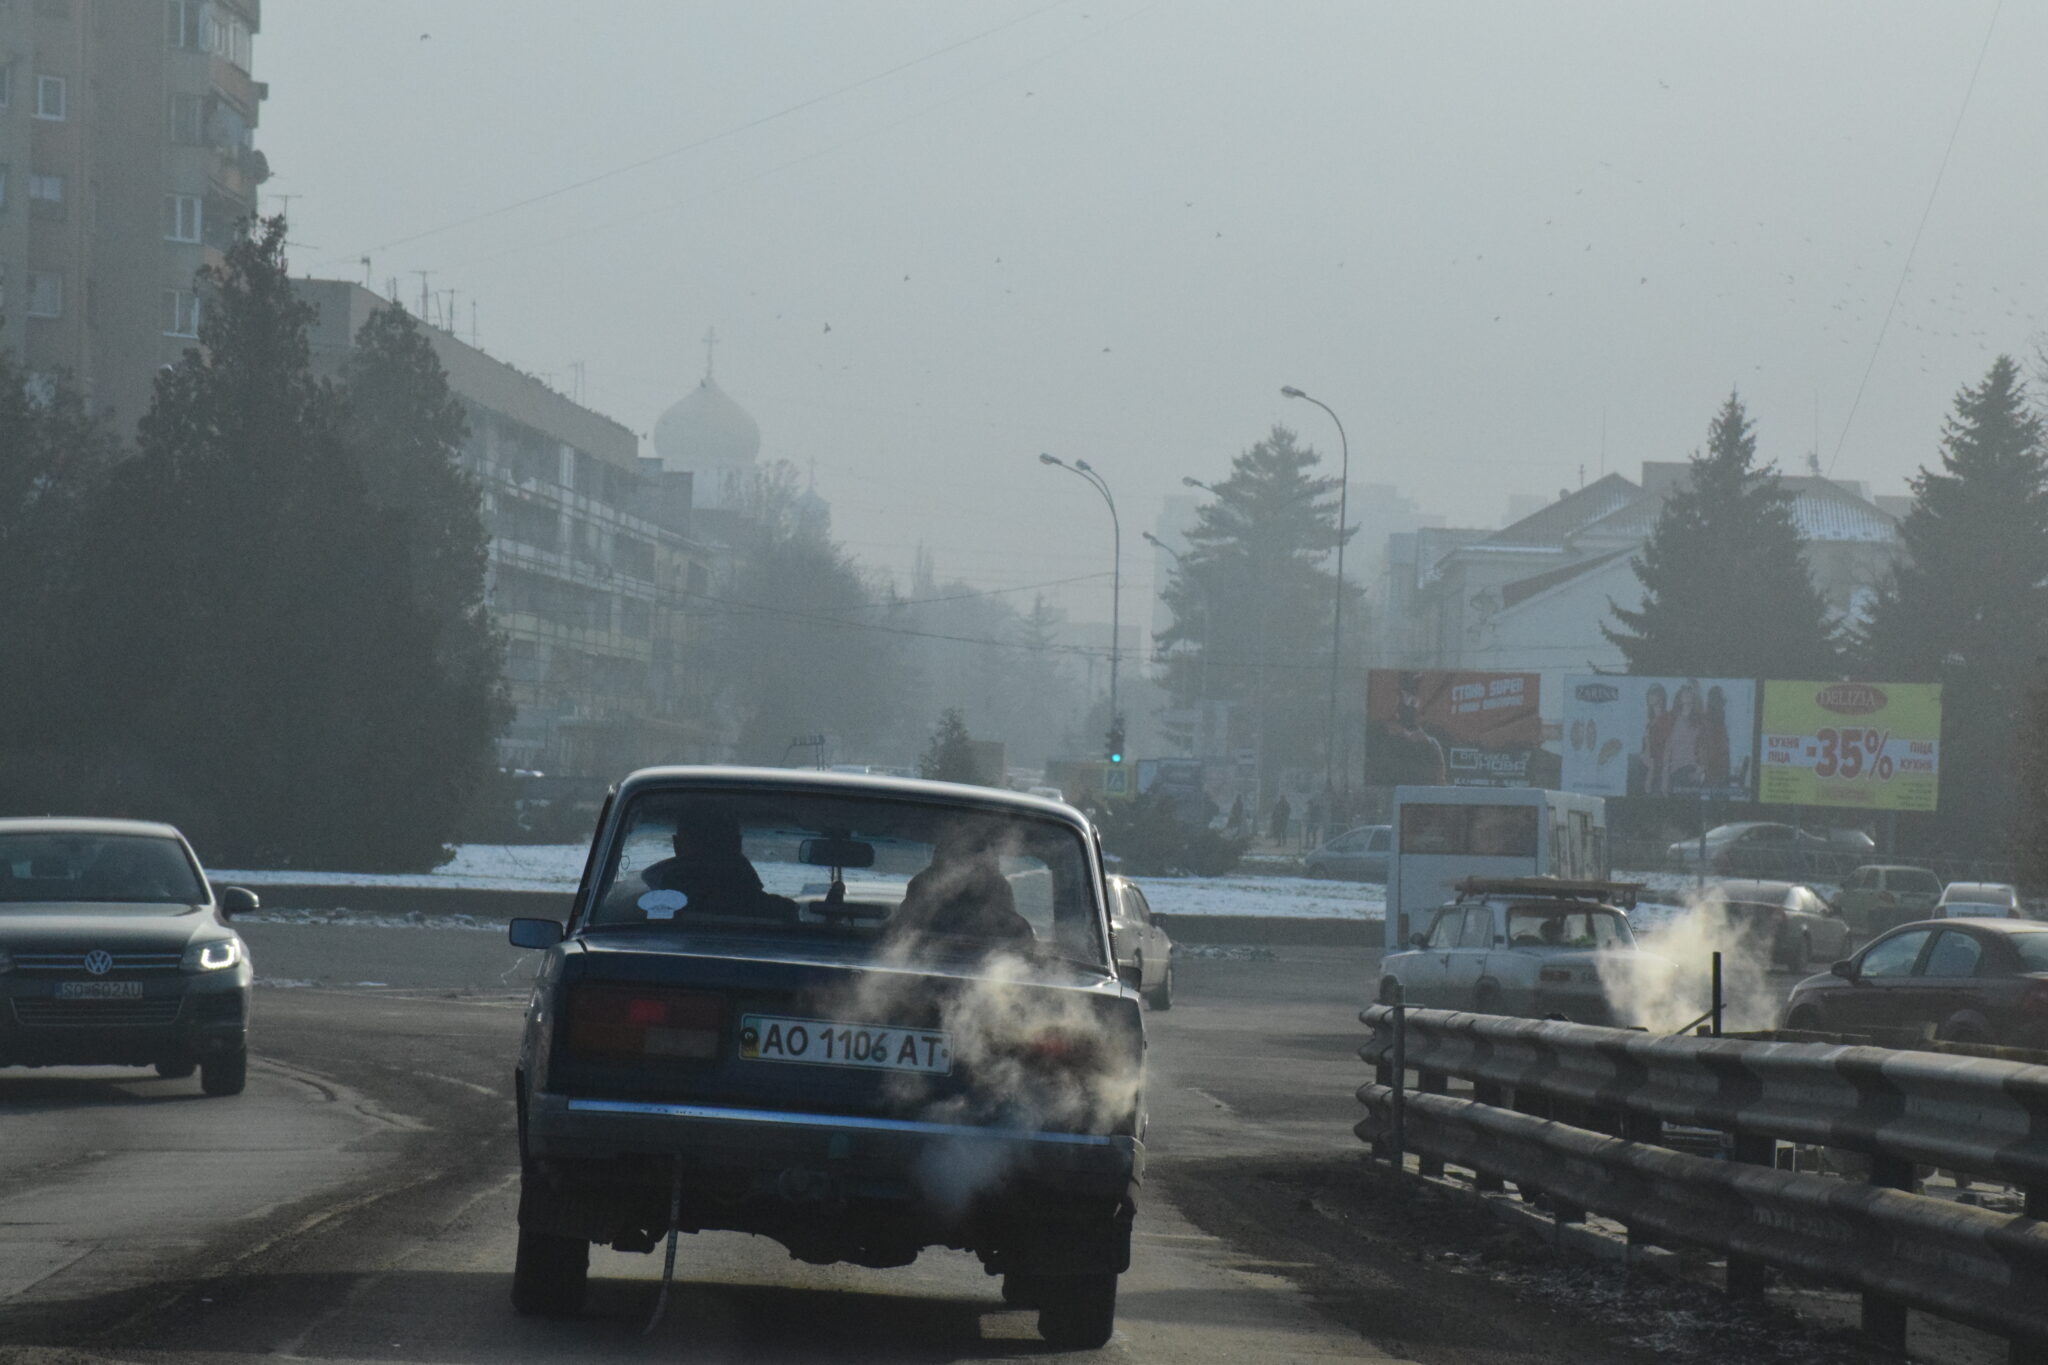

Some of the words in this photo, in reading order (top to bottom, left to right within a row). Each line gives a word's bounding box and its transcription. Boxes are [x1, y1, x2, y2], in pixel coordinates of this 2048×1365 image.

[1819, 690, 1875, 707] DELIZIA
[1767, 736, 1800, 749] КУХНЯ
[1910, 740, 1933, 755] ПІЦА
[1767, 750, 1791, 764] ПІЦА
[1806, 727, 1893, 781] -35%
[763, 1024, 808, 1056] AO
[819, 1027, 889, 1063] 1106
[896, 1034, 944, 1067] AT
